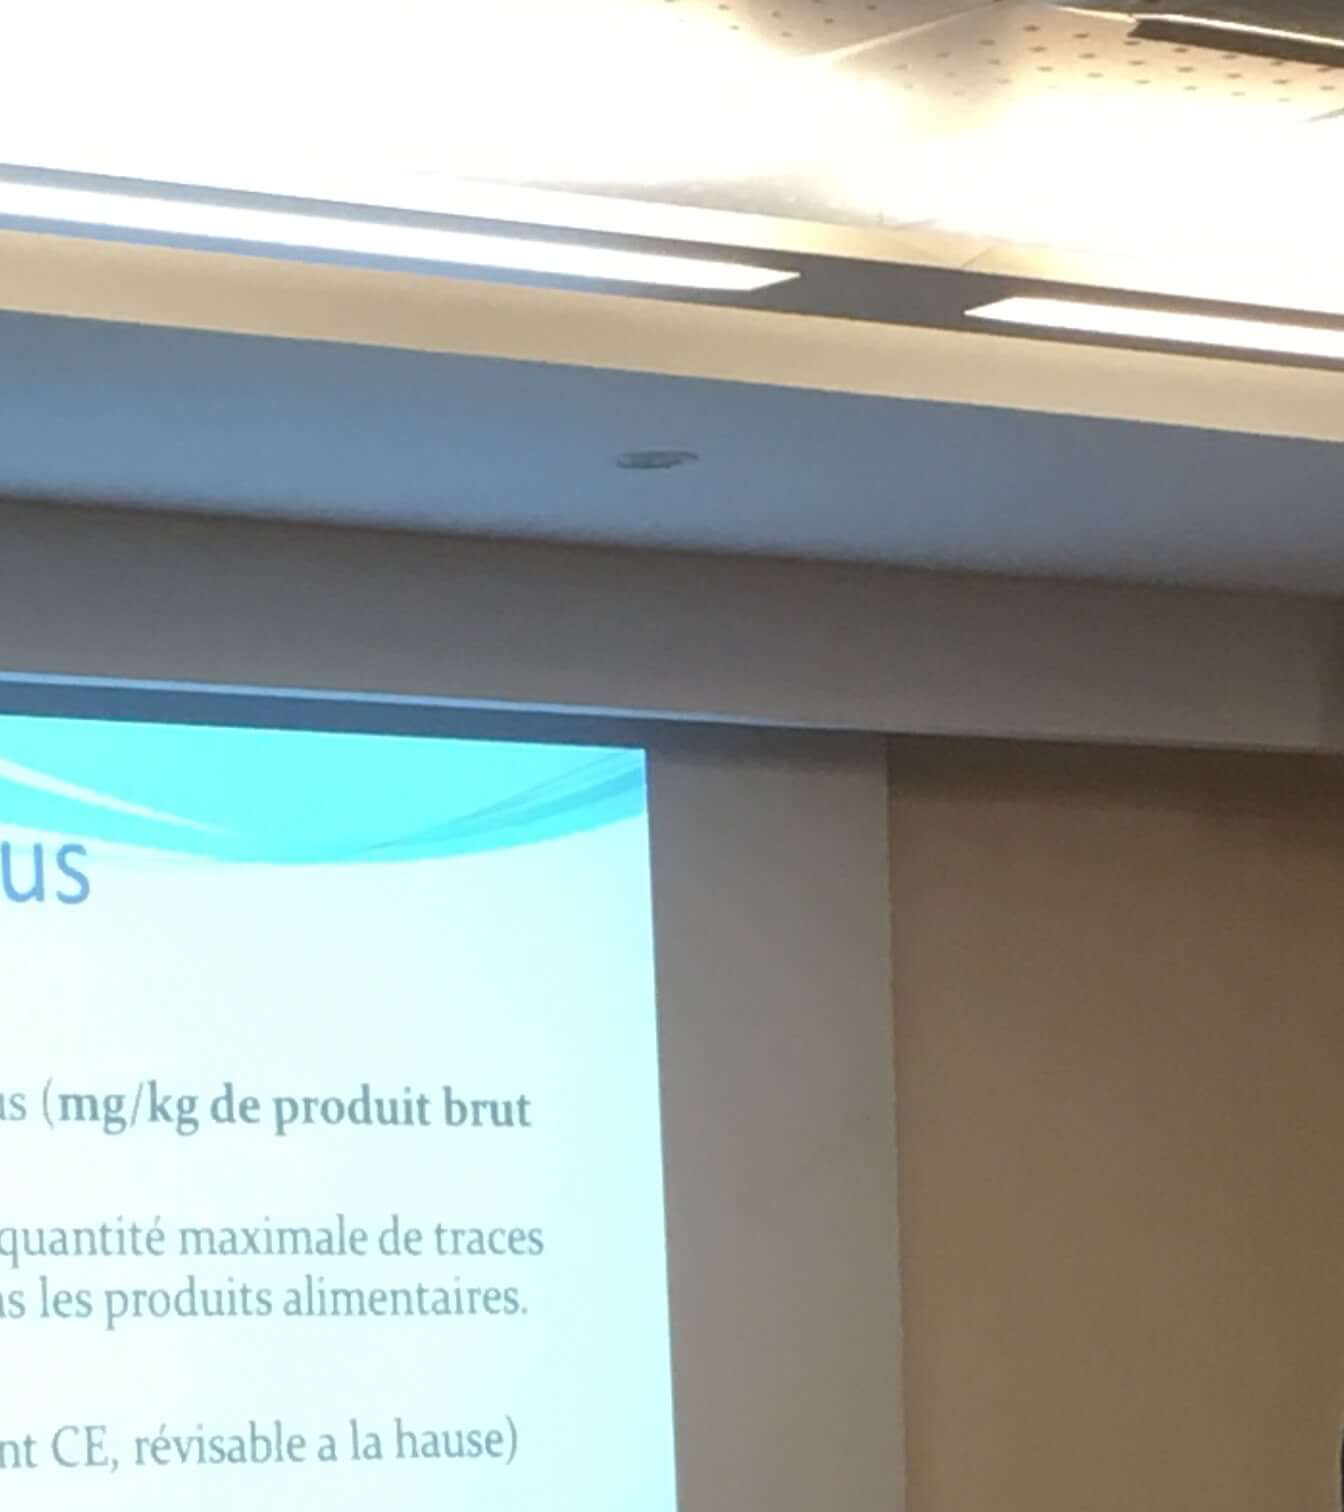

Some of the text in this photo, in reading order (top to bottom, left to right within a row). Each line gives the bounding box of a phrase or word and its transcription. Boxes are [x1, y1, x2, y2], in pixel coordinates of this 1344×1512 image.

[43, 1080, 199, 1136] (mg/kg
[210, 1082, 260, 1123] de
[272, 1083, 431, 1136] produit
[443, 1085, 531, 1127] brut
[178, 1214, 368, 1256] maximale
[378, 1214, 423, 1256] de
[434, 1224, 544, 1256] traces
[40, 1275, 93, 1318] les
[104, 1275, 272, 1331] produits
[283, 1274, 527, 1316] alimentaires.
[51, 1425, 118, 1472] CE,
[135, 1420, 306, 1465] révisable
[318, 1434, 337, 1462] a
[350, 1418, 383, 1460] la
[394, 1416, 517, 1465] hause)
